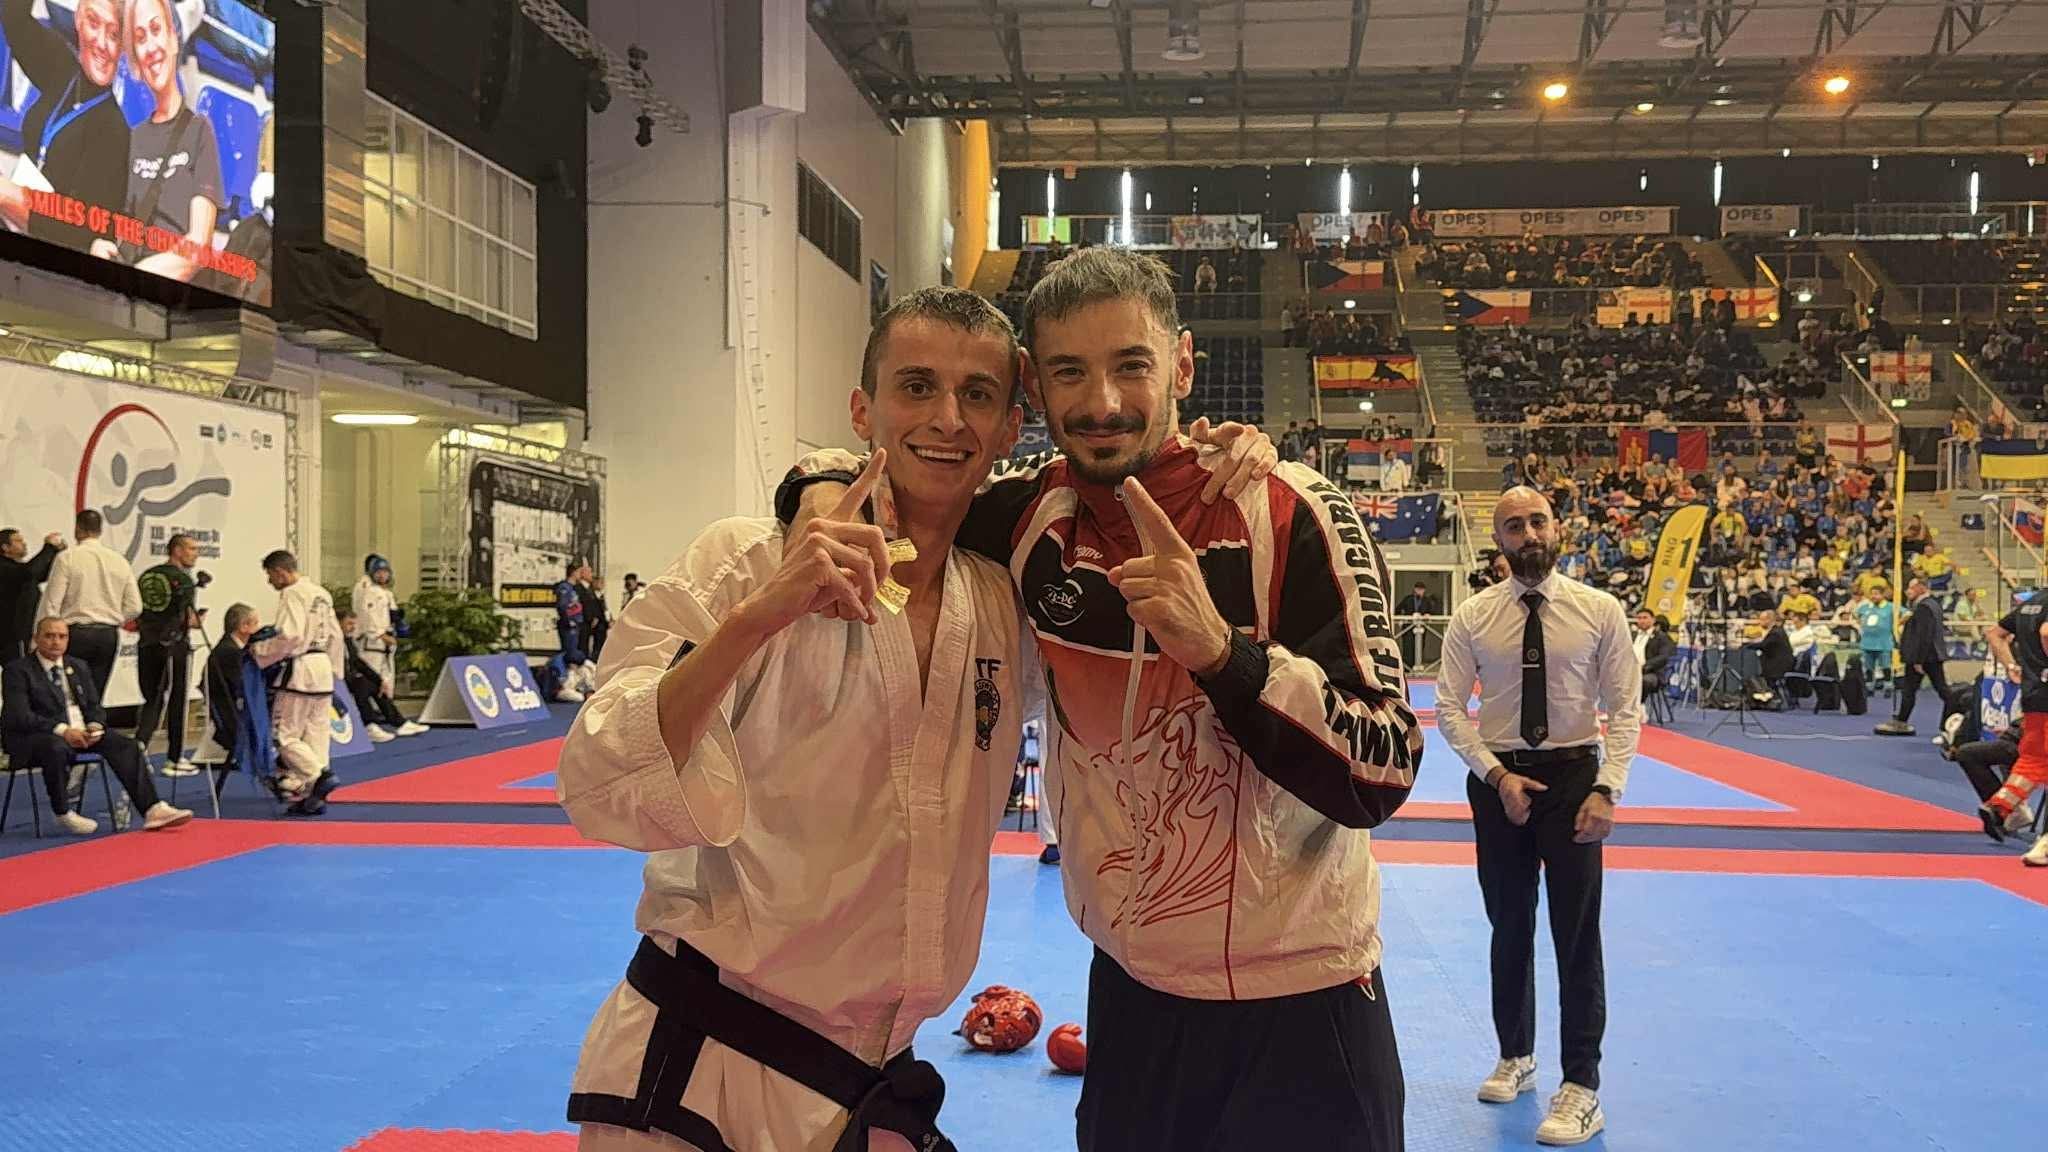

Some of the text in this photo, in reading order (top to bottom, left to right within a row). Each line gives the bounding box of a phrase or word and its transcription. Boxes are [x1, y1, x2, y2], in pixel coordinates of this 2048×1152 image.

[23, 188, 86, 226] SMILES
[86, 203, 112, 234] OF
[112, 212, 145, 247] THE
[1311, 213, 1354, 228] OPES
[1442, 209, 1646, 226] OPES OPES OPES
[1726, 207, 1774, 221] OPES
[1662, 537, 1678, 567] RING
[1679, 537, 1694, 568] 1
